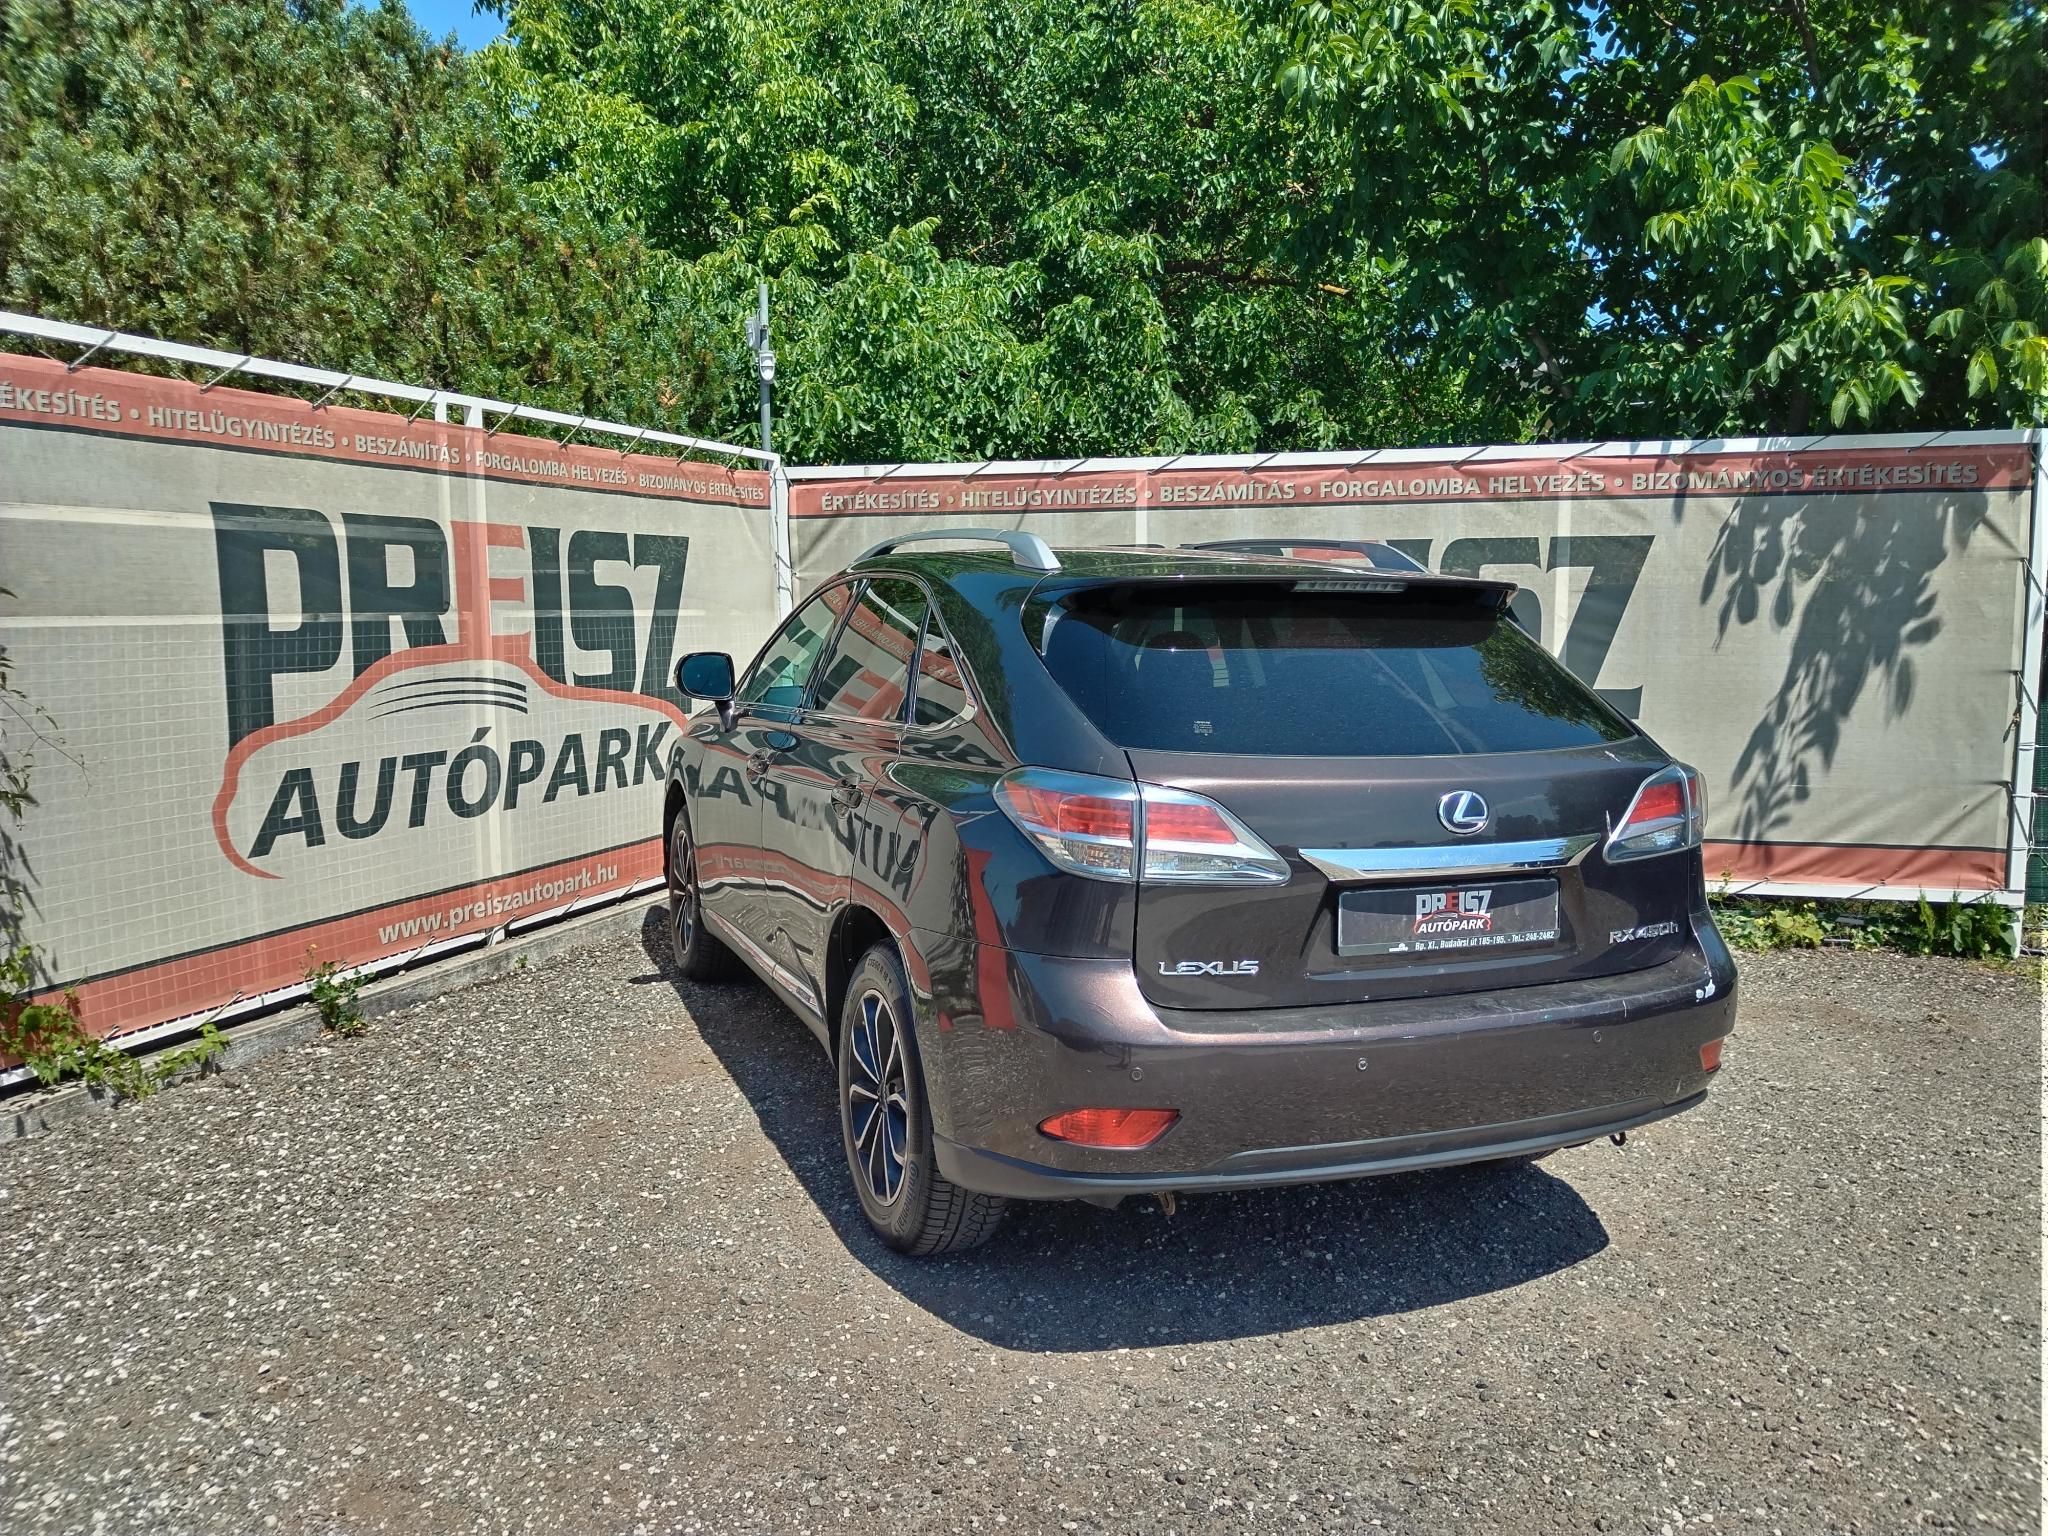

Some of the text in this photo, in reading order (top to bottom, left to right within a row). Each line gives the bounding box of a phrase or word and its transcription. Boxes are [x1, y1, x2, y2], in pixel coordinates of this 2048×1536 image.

[149, 405, 336, 449] HITELÜGYINTÉZÉS
[355, 434, 460, 464] BESZÁMÍTÁS
[475, 451, 568, 478] FORGALOMBA
[572, 465, 628, 485] HELYEZÉS
[639, 474, 707, 495] BIZOMÁNYOS
[821, 462, 1979, 511] ÉRTÉKESÍTÉS HITELÜGYINTÉZÉS BESZÁMÍTÁS FORGALOMBA HELYEZÉS BIZOMÁNYOS ÉRTÉKESÍTÉS
[208, 501, 691, 752] PREISZ
[247, 721, 673, 859] AUTÓPARK
[378, 863, 618, 945] www.preiszautopark.hu
[1416, 890, 1492, 920] PREISZ
[1417, 918, 1485, 934] AUTÓPARK
[1608, 921, 1679, 944] RX 450h
[1158, 960, 1260, 976] LEXUS
